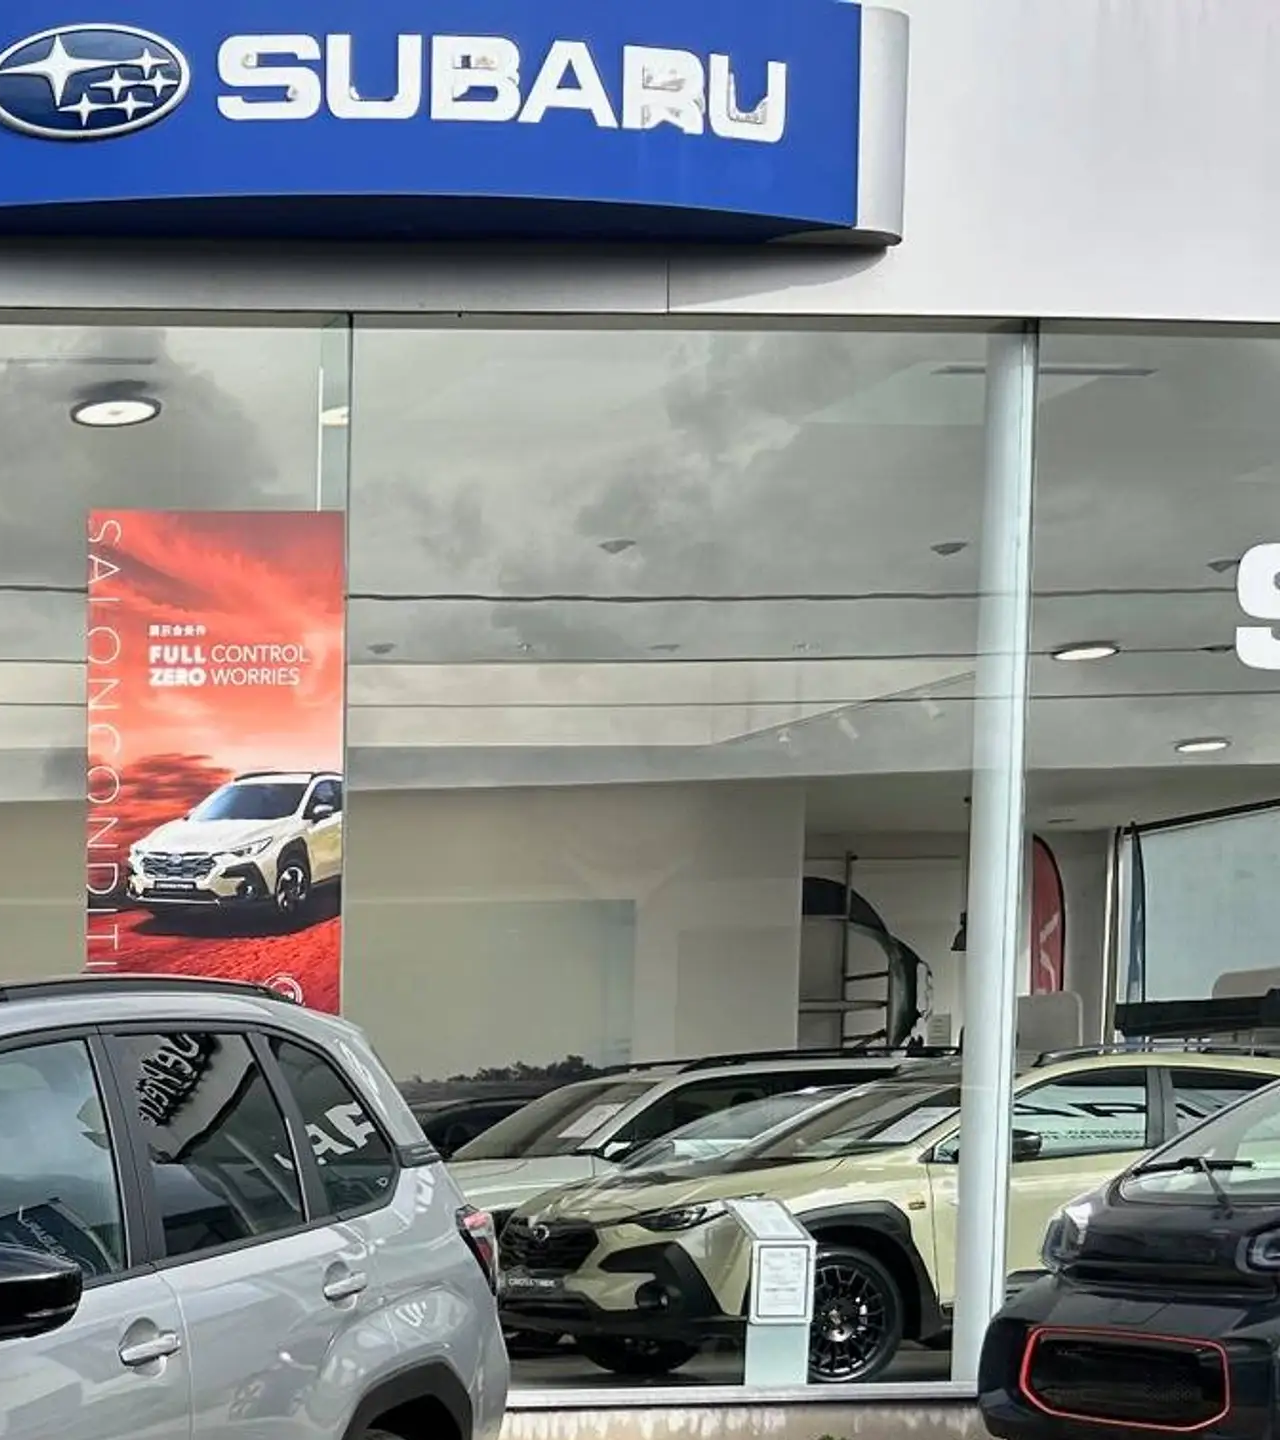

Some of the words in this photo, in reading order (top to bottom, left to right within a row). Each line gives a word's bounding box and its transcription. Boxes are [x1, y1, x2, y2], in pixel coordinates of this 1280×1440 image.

[216, 34, 787, 143] SUBARU
[149, 644, 207, 664] FULL
[211, 644, 311, 663] CONTROL
[149, 667, 207, 687] ZERO
[211, 667, 300, 686] WORRIES
